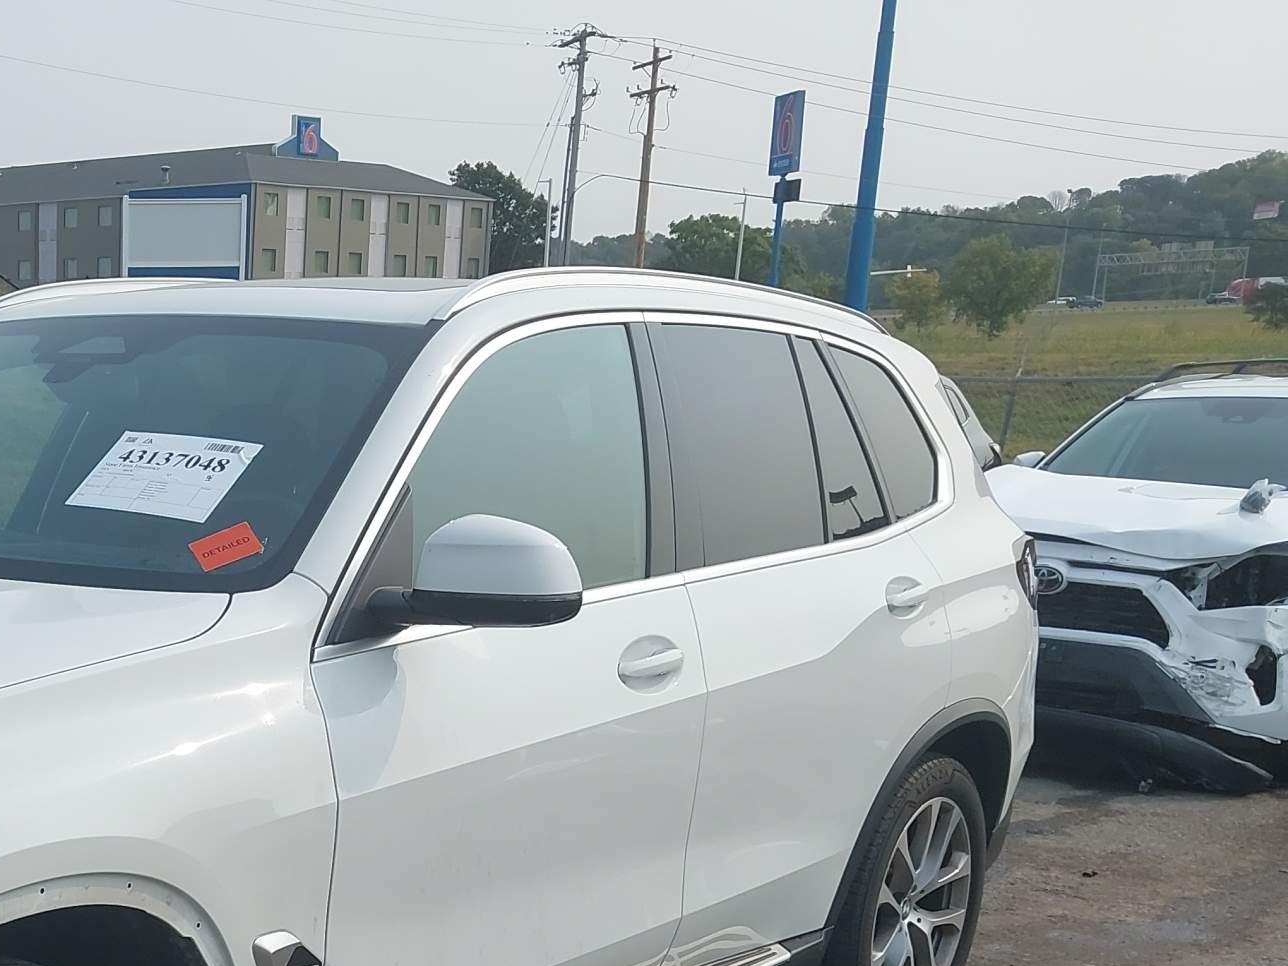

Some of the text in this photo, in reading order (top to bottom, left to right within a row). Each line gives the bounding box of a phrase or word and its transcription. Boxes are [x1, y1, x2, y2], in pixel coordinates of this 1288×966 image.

[304, 124, 318, 154] 6
[118, 448, 231, 473] 43137048
[202, 536, 250, 559] DETAILED
